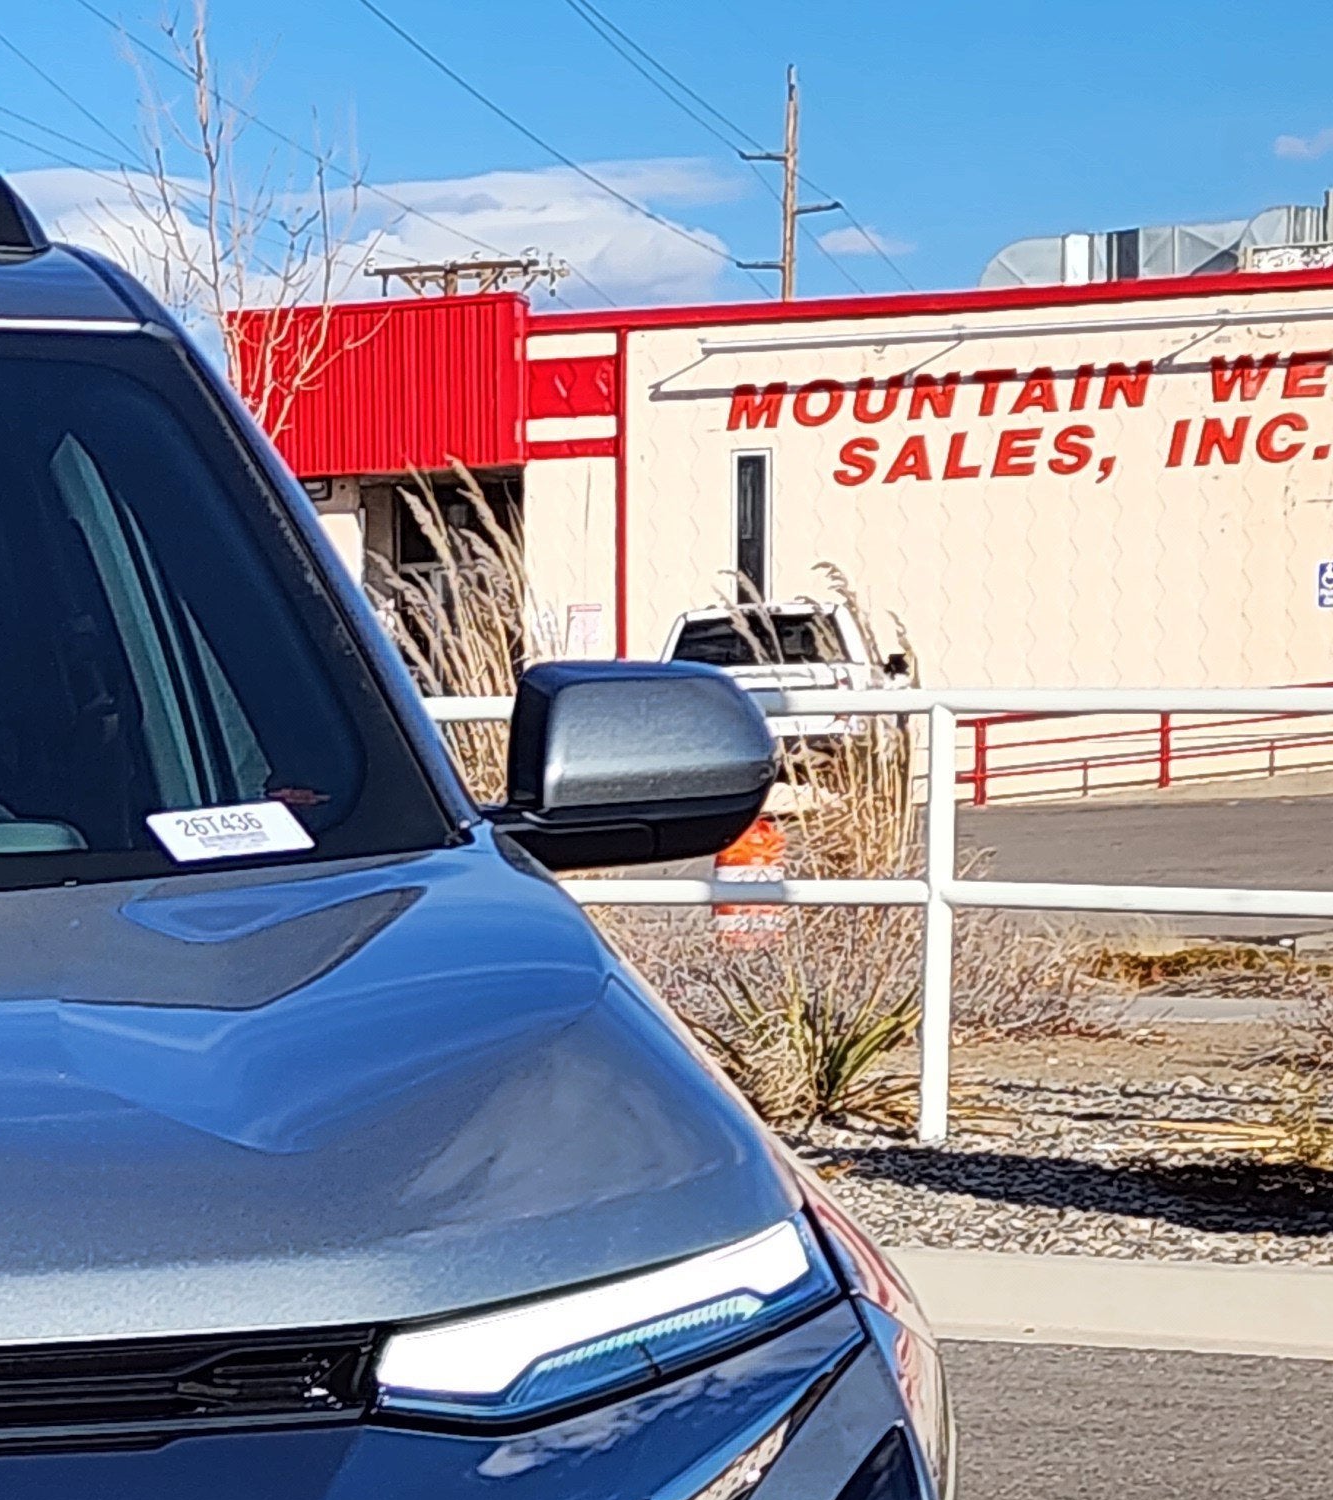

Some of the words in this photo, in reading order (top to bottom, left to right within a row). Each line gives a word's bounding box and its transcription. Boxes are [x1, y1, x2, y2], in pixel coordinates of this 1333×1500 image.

[726, 360, 1154, 431] MOUNTAIN
[1210, 349, 1333, 403] WE
[832, 424, 1117, 486] SALES,
[1165, 411, 1332, 467] INC.
[175, 812, 264, 838] 26T436
